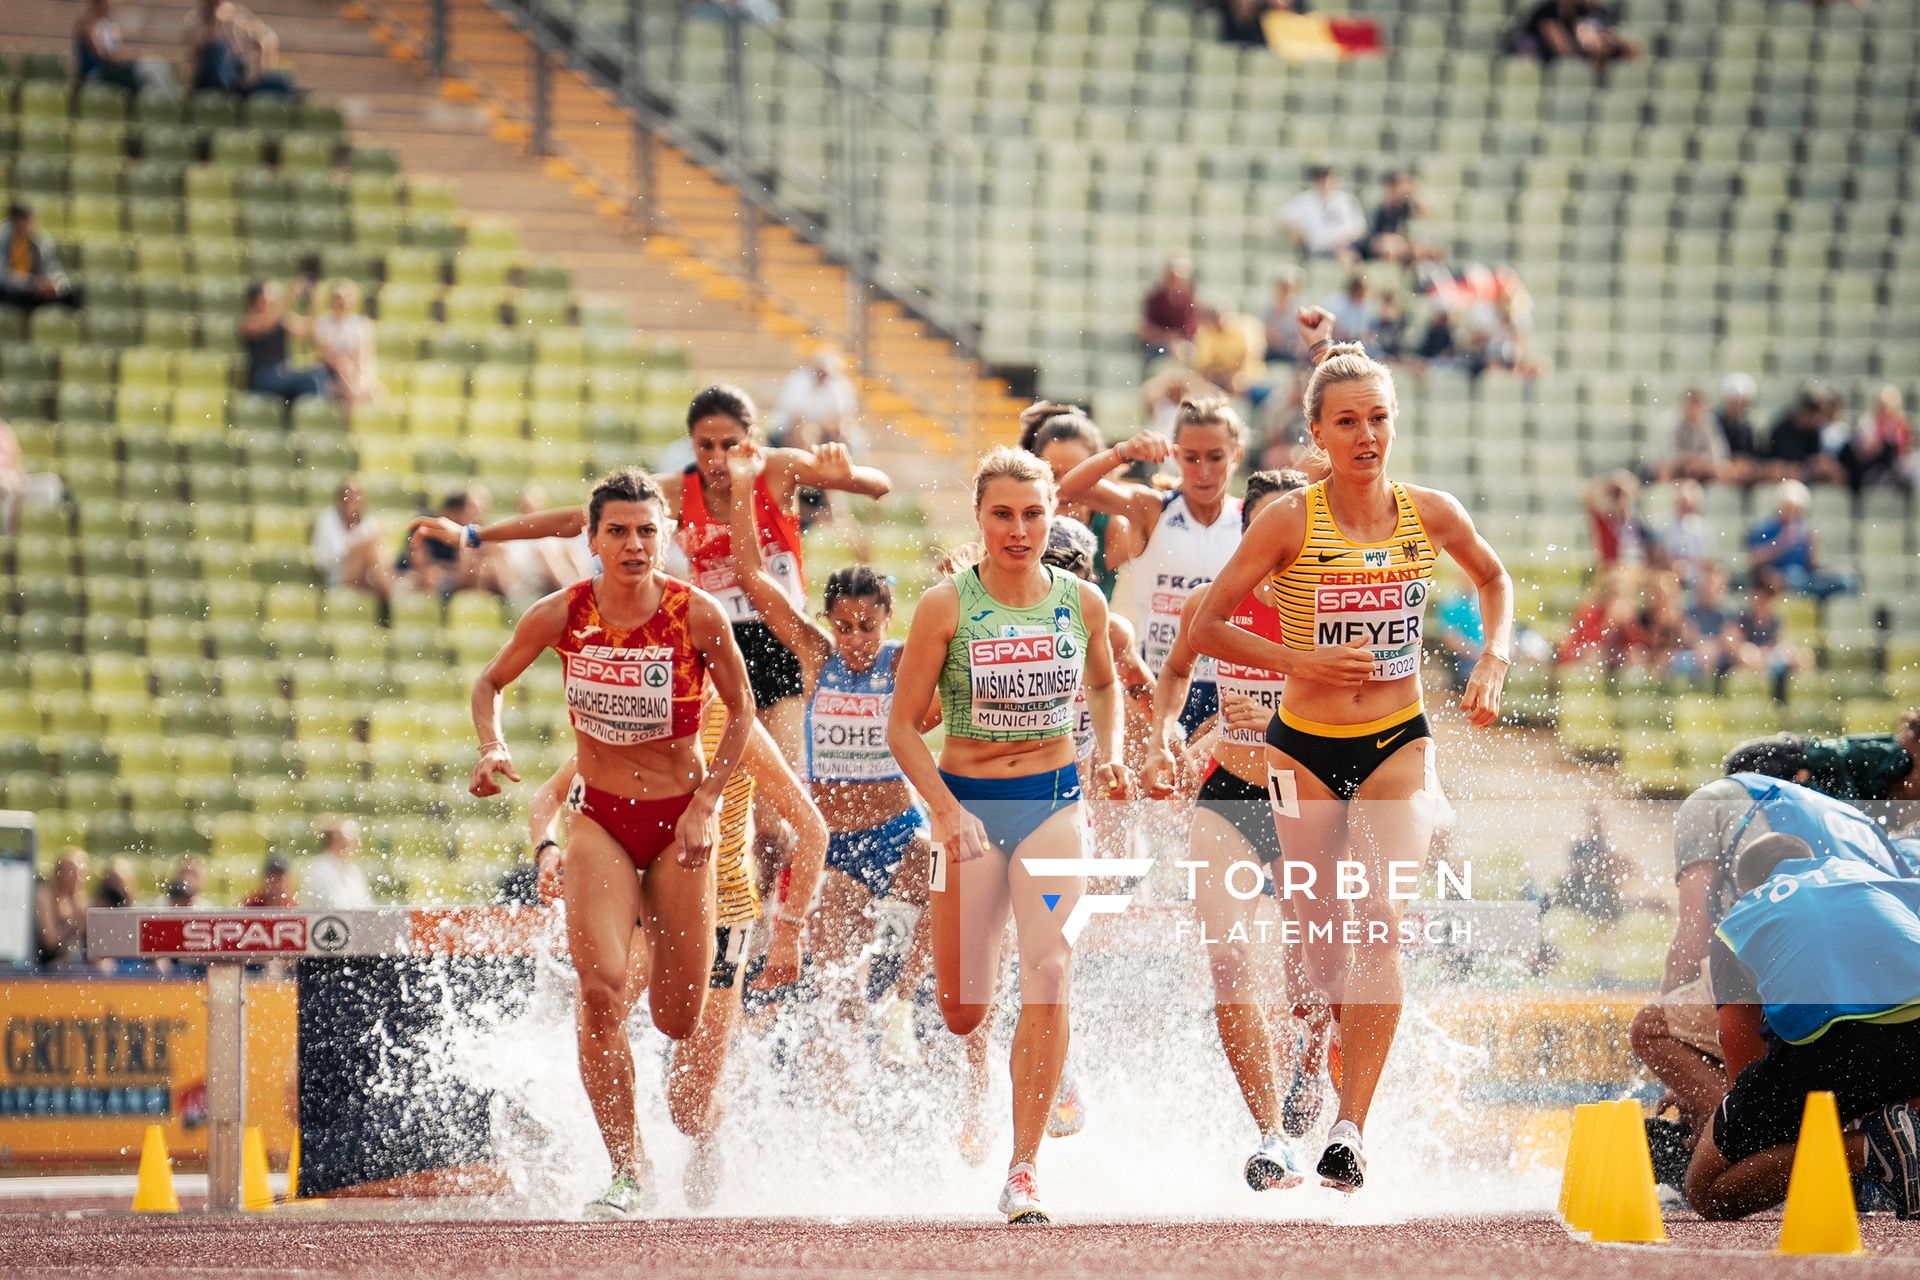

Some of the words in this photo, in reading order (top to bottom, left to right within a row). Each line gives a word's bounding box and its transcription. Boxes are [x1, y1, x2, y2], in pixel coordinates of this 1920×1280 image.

[1320, 568, 1421, 585] GERMANY
[1320, 588, 1400, 610] SPAR
[1318, 615, 1420, 645] MEYER
[580, 645, 674, 660] ESPAÑA
[973, 639, 1052, 663] SPAR
[571, 658, 640, 684] SPAR
[1389, 657, 1415, 676] 2022
[975, 669, 1025, 699] MIŠMAŠ
[1028, 665, 1079, 697] ZRIMŠEK
[567, 685, 668, 719] SÁNCHEZ-ESCRIBANO
[816, 695, 879, 715] SPAR
[1004, 703, 1025, 711] RUN
[1027, 701, 1055, 711] CLEAN
[978, 712, 1037, 727] MUNICH
[1042, 706, 1067, 726] 2022
[580, 717, 626, 742] MUNICH
[631, 728, 665, 742] 2022
[814, 724, 887, 746] COHE
[182, 921, 304, 949] SPAR
